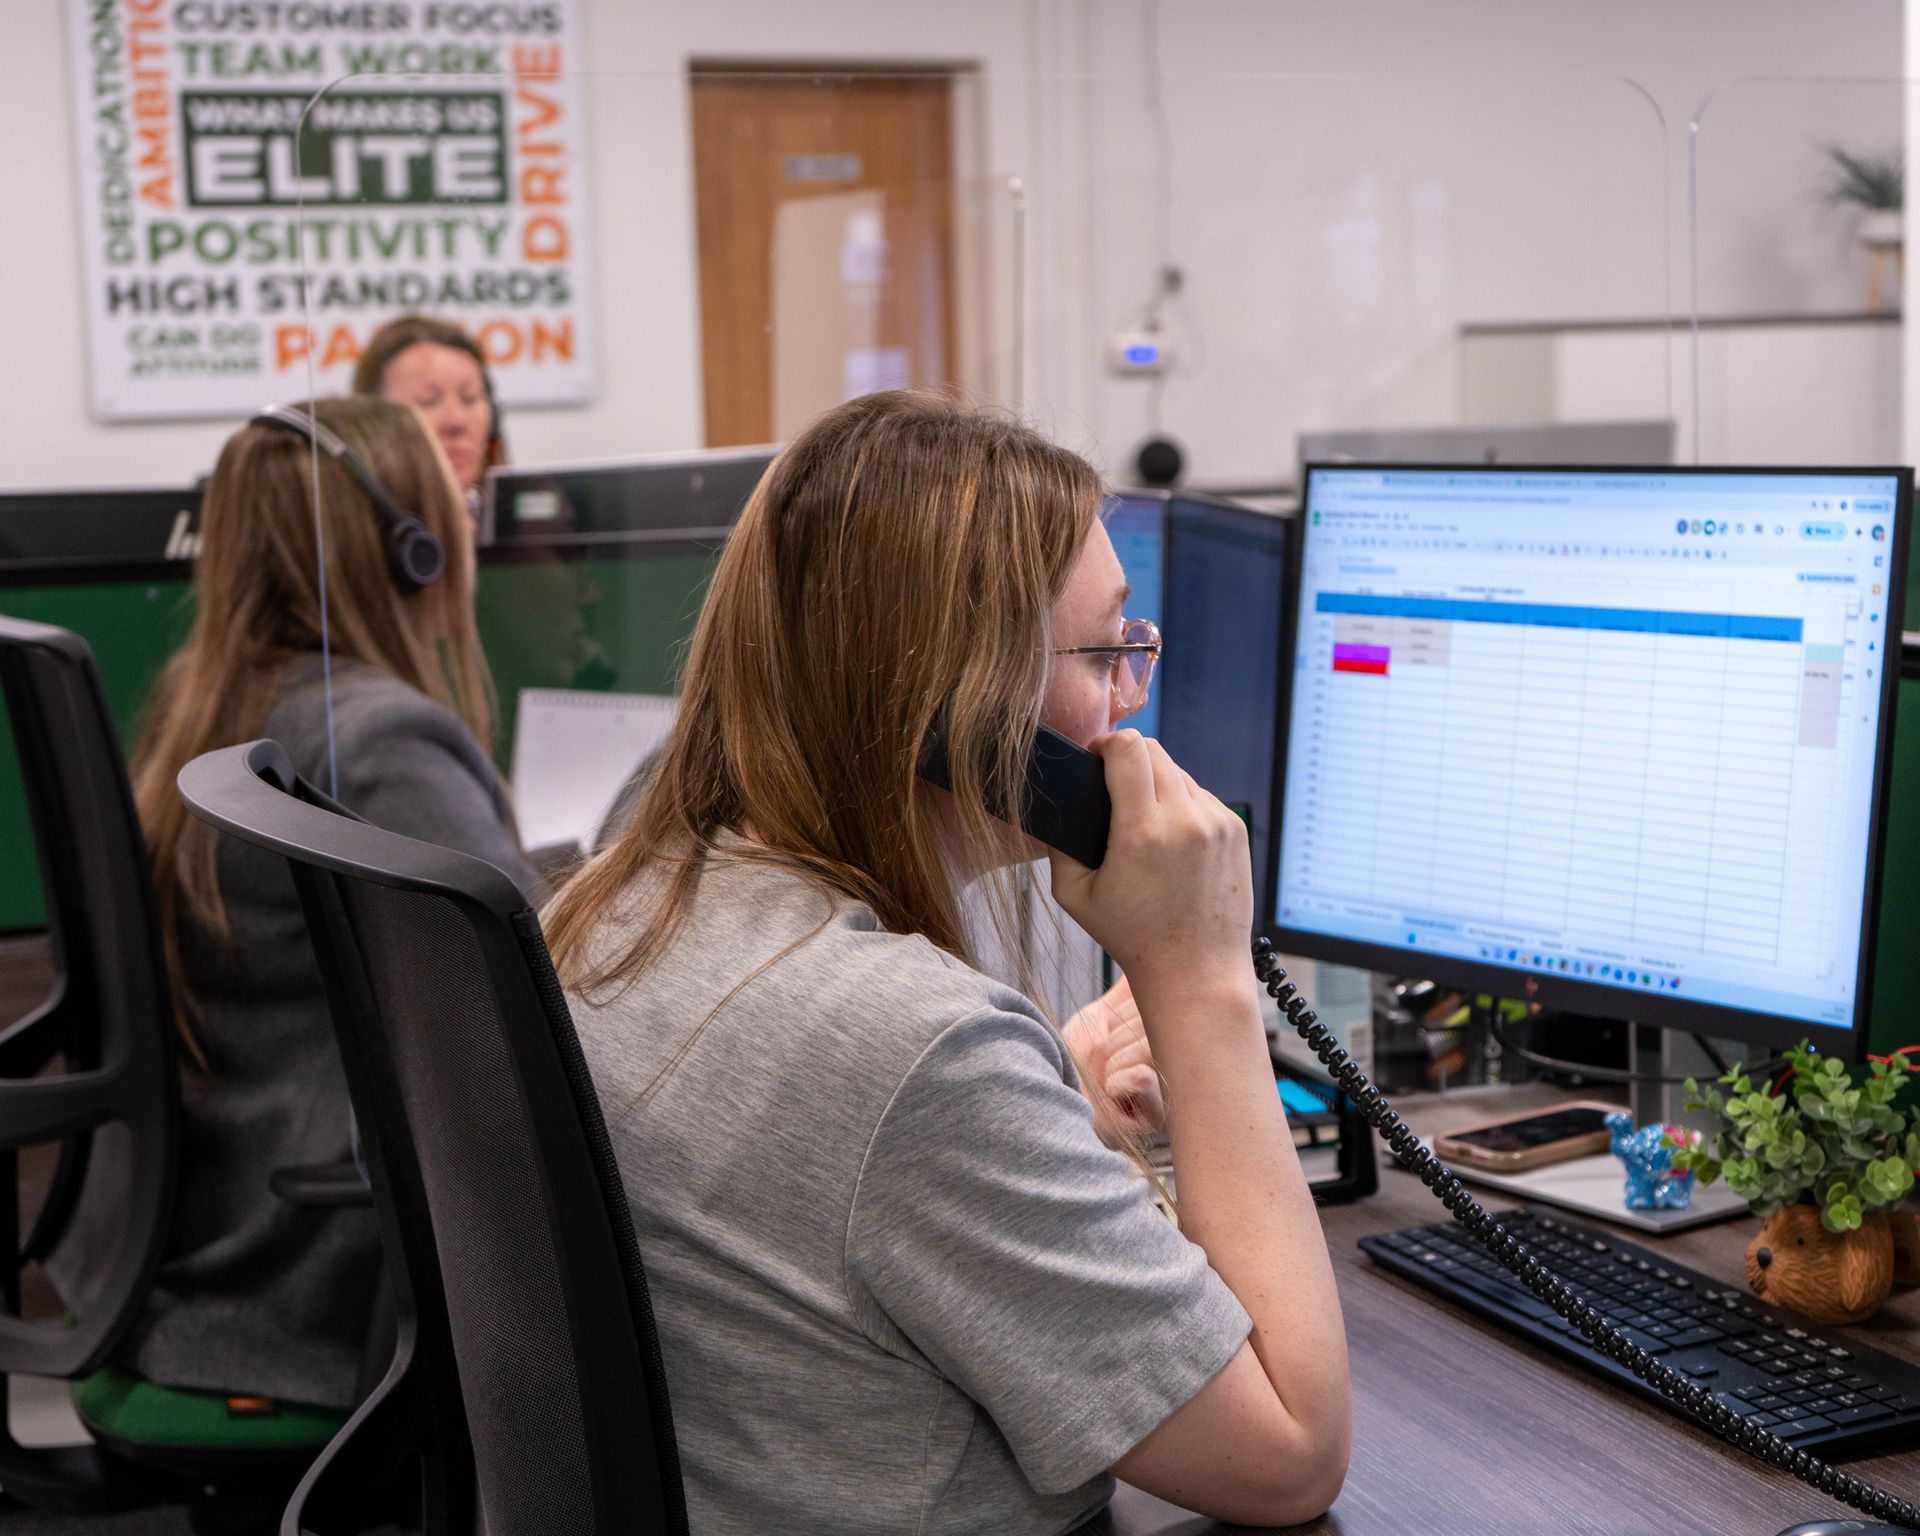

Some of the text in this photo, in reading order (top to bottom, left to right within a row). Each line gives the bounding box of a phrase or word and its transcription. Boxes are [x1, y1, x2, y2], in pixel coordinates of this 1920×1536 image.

[173, 2, 562, 33] CUSTOMER FOCUS
[178, 42, 500, 75] TEAM WORK
[187, 98, 498, 132] WHAT MAKES US
[191, 134, 501, 200] ELITE
[513, 44, 570, 263] DRIVE
[145, 218, 507, 265] POSITIVITY
[107, 269, 572, 316] HIGH STANDARDS
[127, 322, 263, 351] CAN DO
[274, 317, 575, 374] PAON
